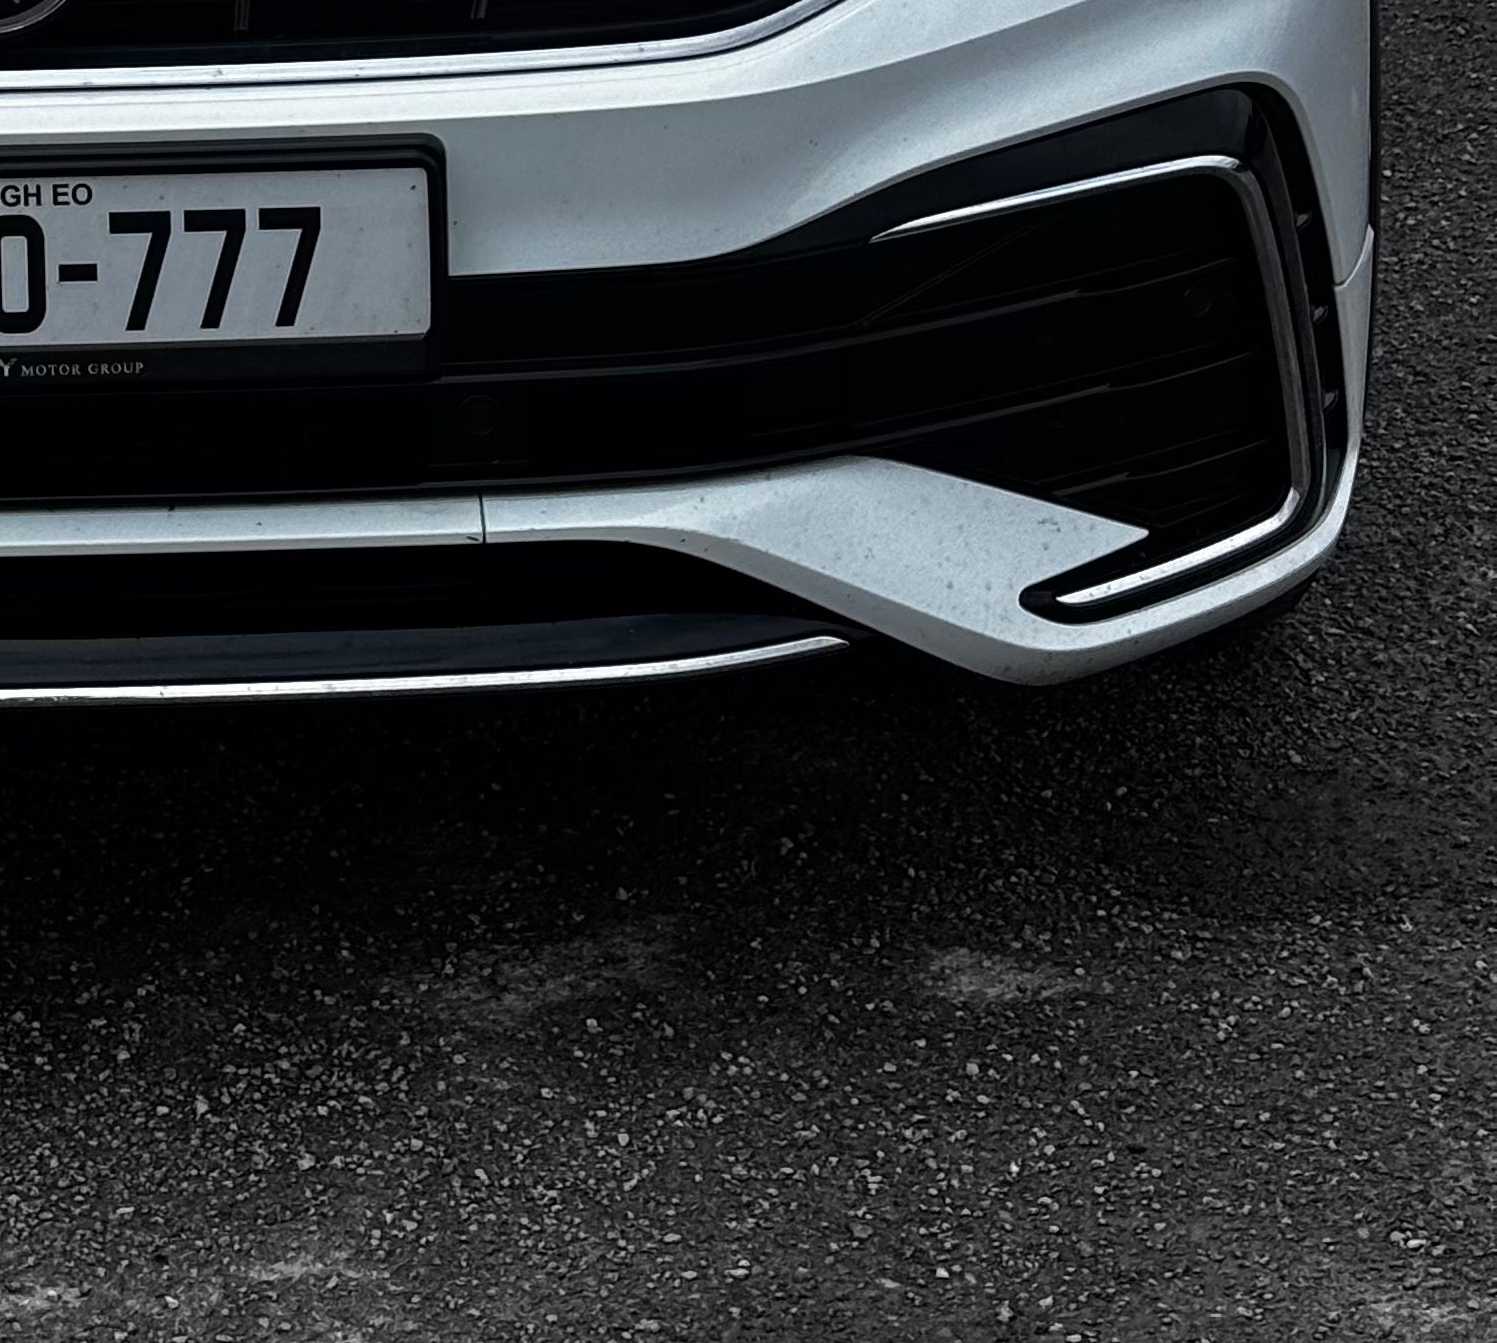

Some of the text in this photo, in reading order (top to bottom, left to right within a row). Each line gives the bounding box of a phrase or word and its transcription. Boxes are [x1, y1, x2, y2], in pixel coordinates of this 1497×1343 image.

[52, 183, 94, 206] EO
[21, 364, 82, 377] MOTOR
[88, 362, 145, 376] GROUP
